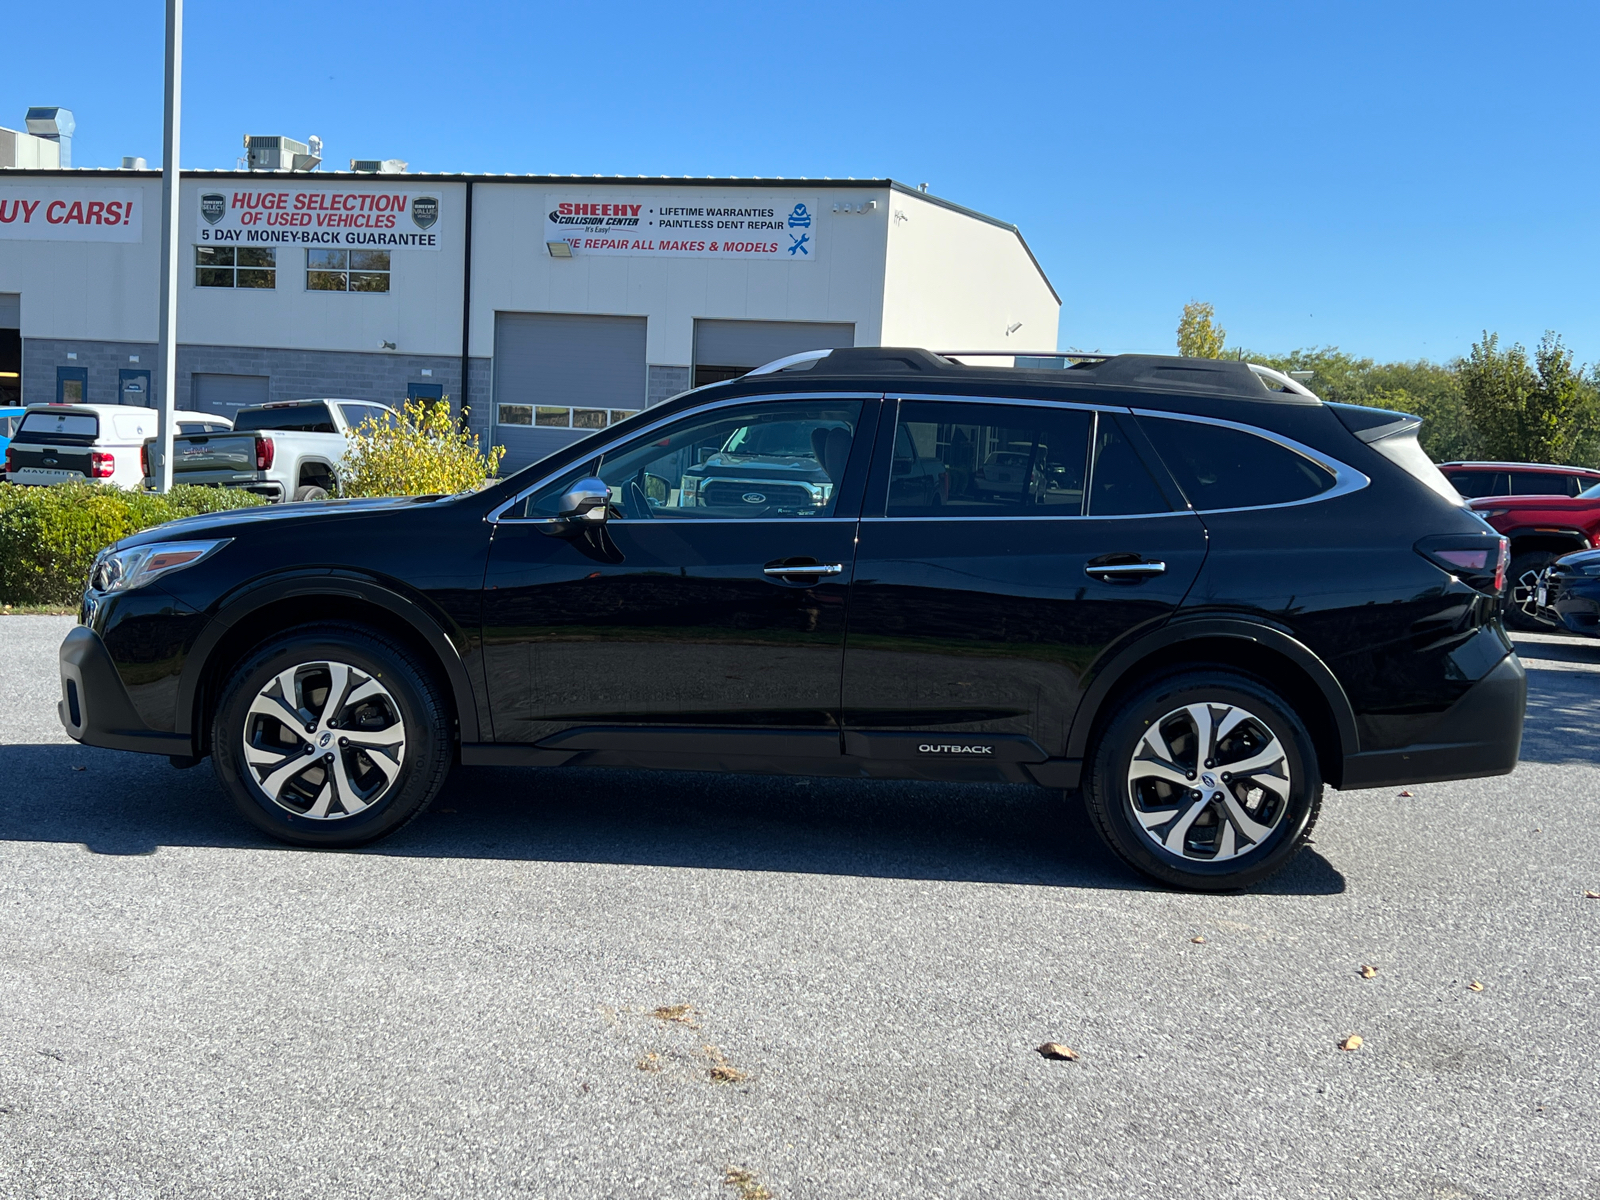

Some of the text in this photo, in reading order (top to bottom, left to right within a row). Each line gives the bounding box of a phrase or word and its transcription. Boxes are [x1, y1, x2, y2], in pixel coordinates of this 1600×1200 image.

[231, 192, 407, 212] HUGE SELECTION
[46, 200, 133, 225] CARS!
[558, 203, 642, 216] SHEEHY
[659, 207, 774, 217] LIFETIME WARRANTIES
[240, 211, 396, 229] OF USED VEHICLES
[558, 216, 640, 226] COLLISION CENTER
[659, 219, 784, 230] PAINTLESS DENT REPAIR
[594, 226, 611, 234] Easy!
[202, 229, 436, 246] 5 DAY MONEY-BACK GUARANTEE
[584, 239, 629, 249] REPAIR
[631, 239, 655, 250] ALL
[659, 240, 705, 251] MAKES
[709, 241, 719, 252] &
[723, 242, 778, 253] MODELS
[918, 744, 992, 754] OUTBACK
